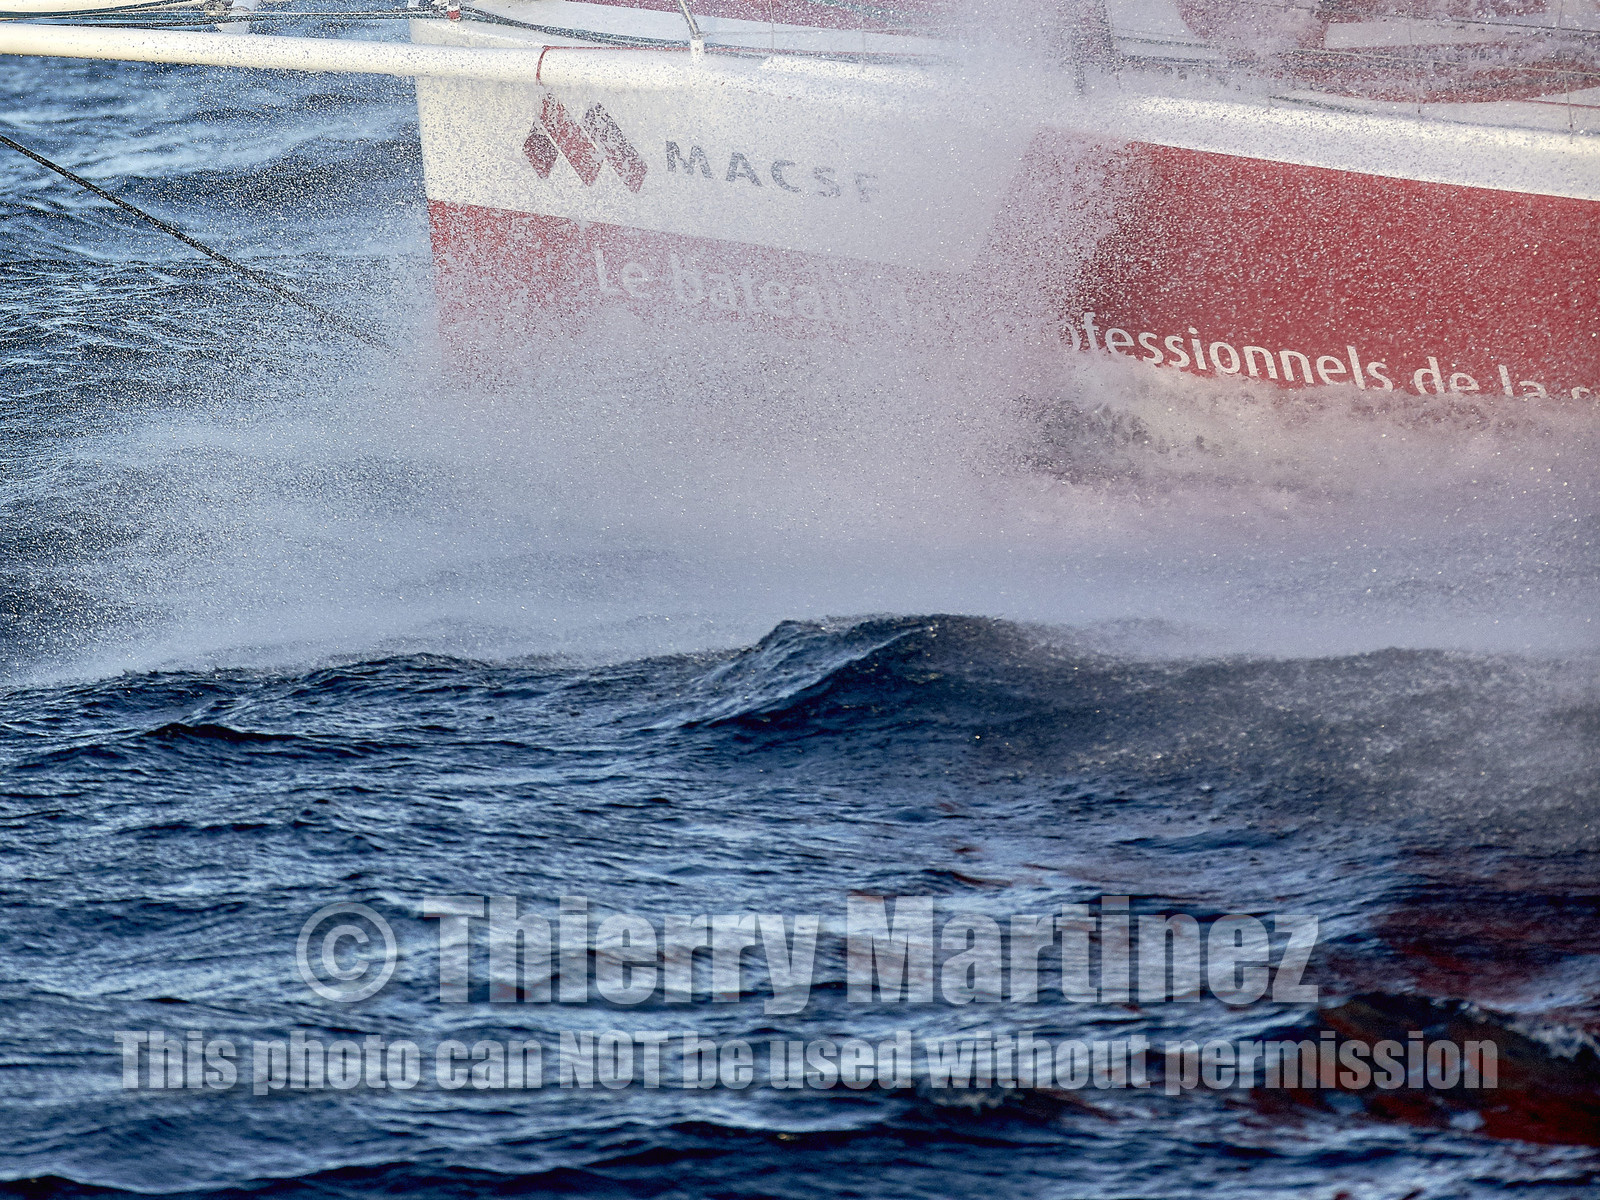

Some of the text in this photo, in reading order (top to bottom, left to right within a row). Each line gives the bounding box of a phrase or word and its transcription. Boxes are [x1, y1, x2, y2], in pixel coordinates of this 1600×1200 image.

[665, 140, 879, 203] MACSF
[595, 246, 652, 300] Le
[1412, 355, 1481, 397] de
